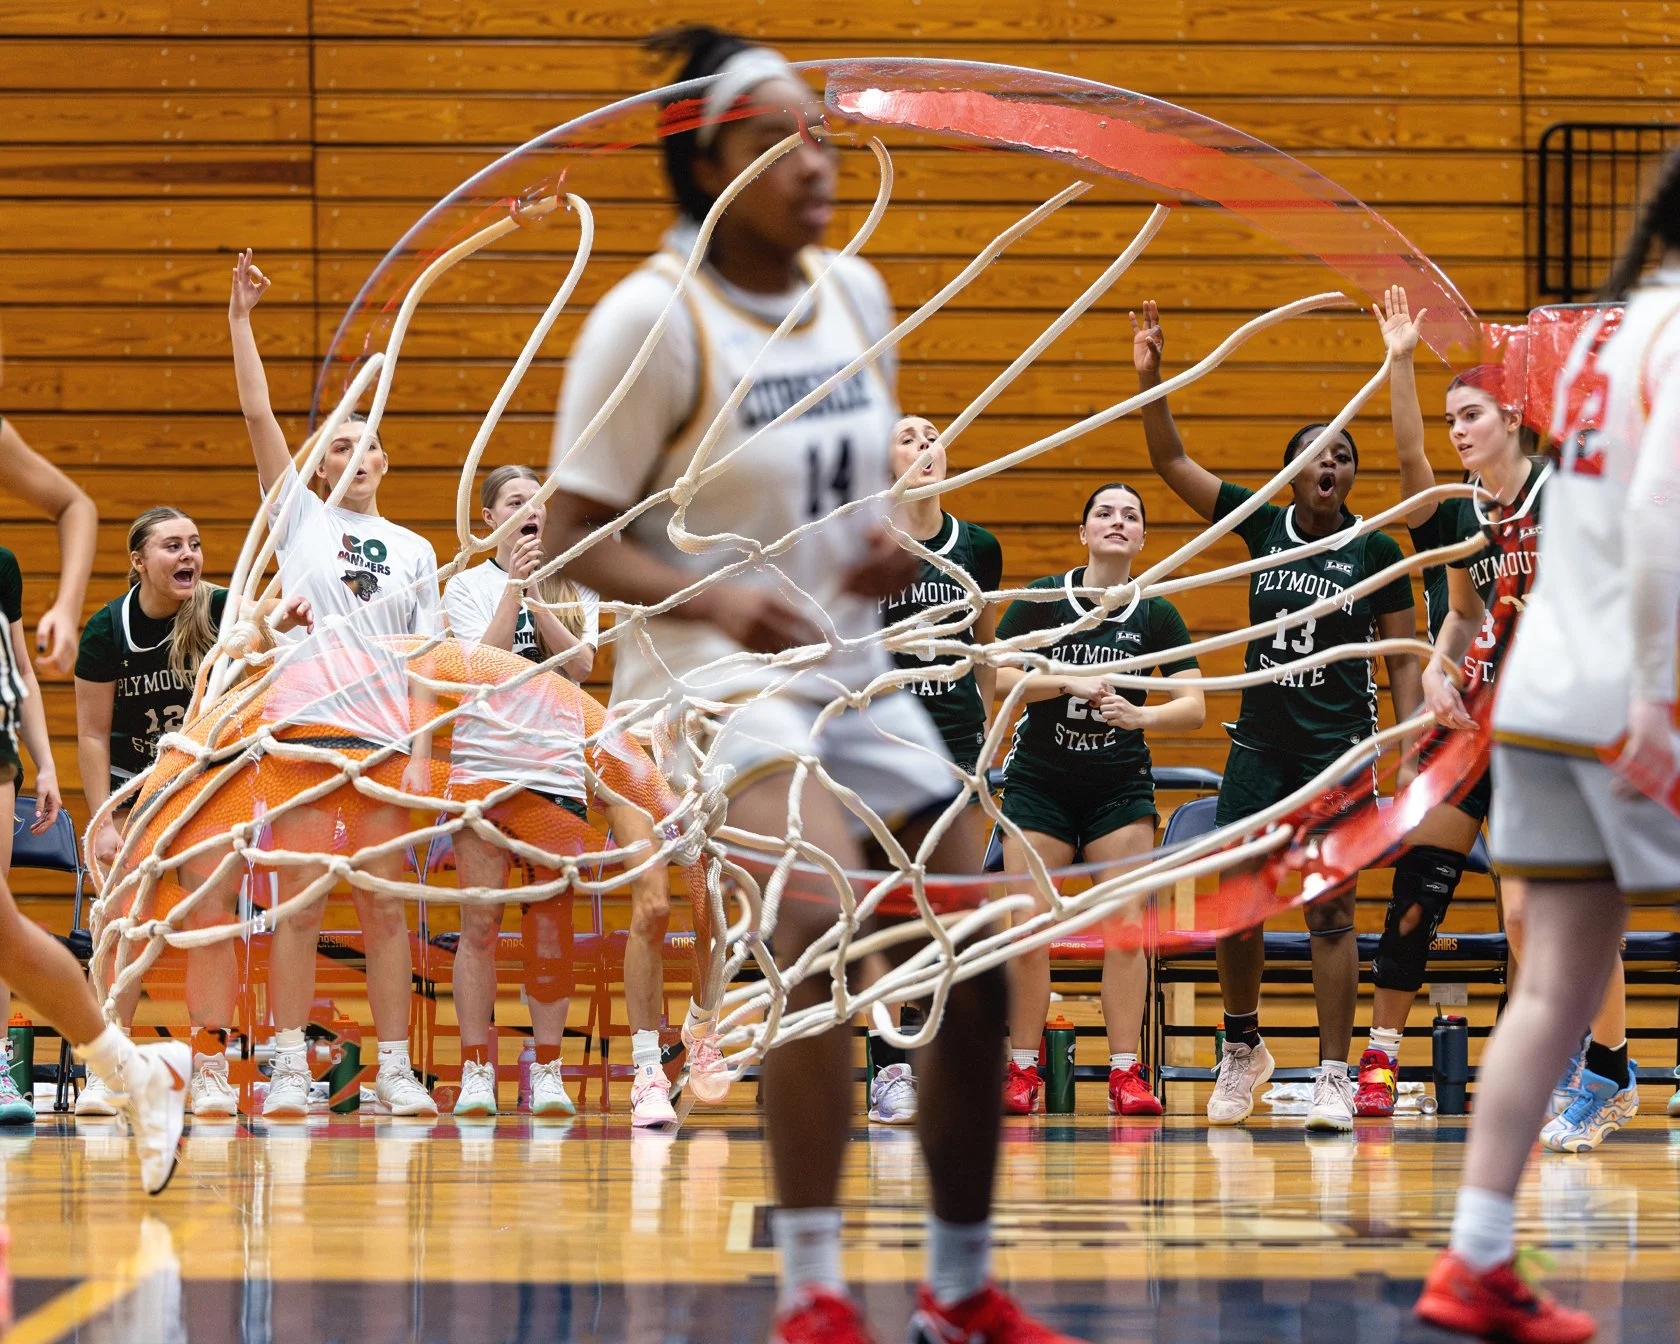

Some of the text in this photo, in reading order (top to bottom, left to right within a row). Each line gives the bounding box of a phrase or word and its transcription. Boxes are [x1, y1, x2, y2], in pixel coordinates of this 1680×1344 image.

[804, 432, 856, 519] 14
[342, 533, 387, 563] GO
[1326, 561, 1352, 574] LEC
[1469, 550, 1543, 590] PLYMOUT
[1255, 569, 1355, 616] PLYMOUTH
[1117, 631, 1141, 643] LEC
[1272, 608, 1317, 654] 13
[117, 669, 203, 697] PLYMOU
[1259, 653, 1327, 687] STATE
[144, 704, 186, 735] 12
[1054, 722, 1117, 751] STATE
